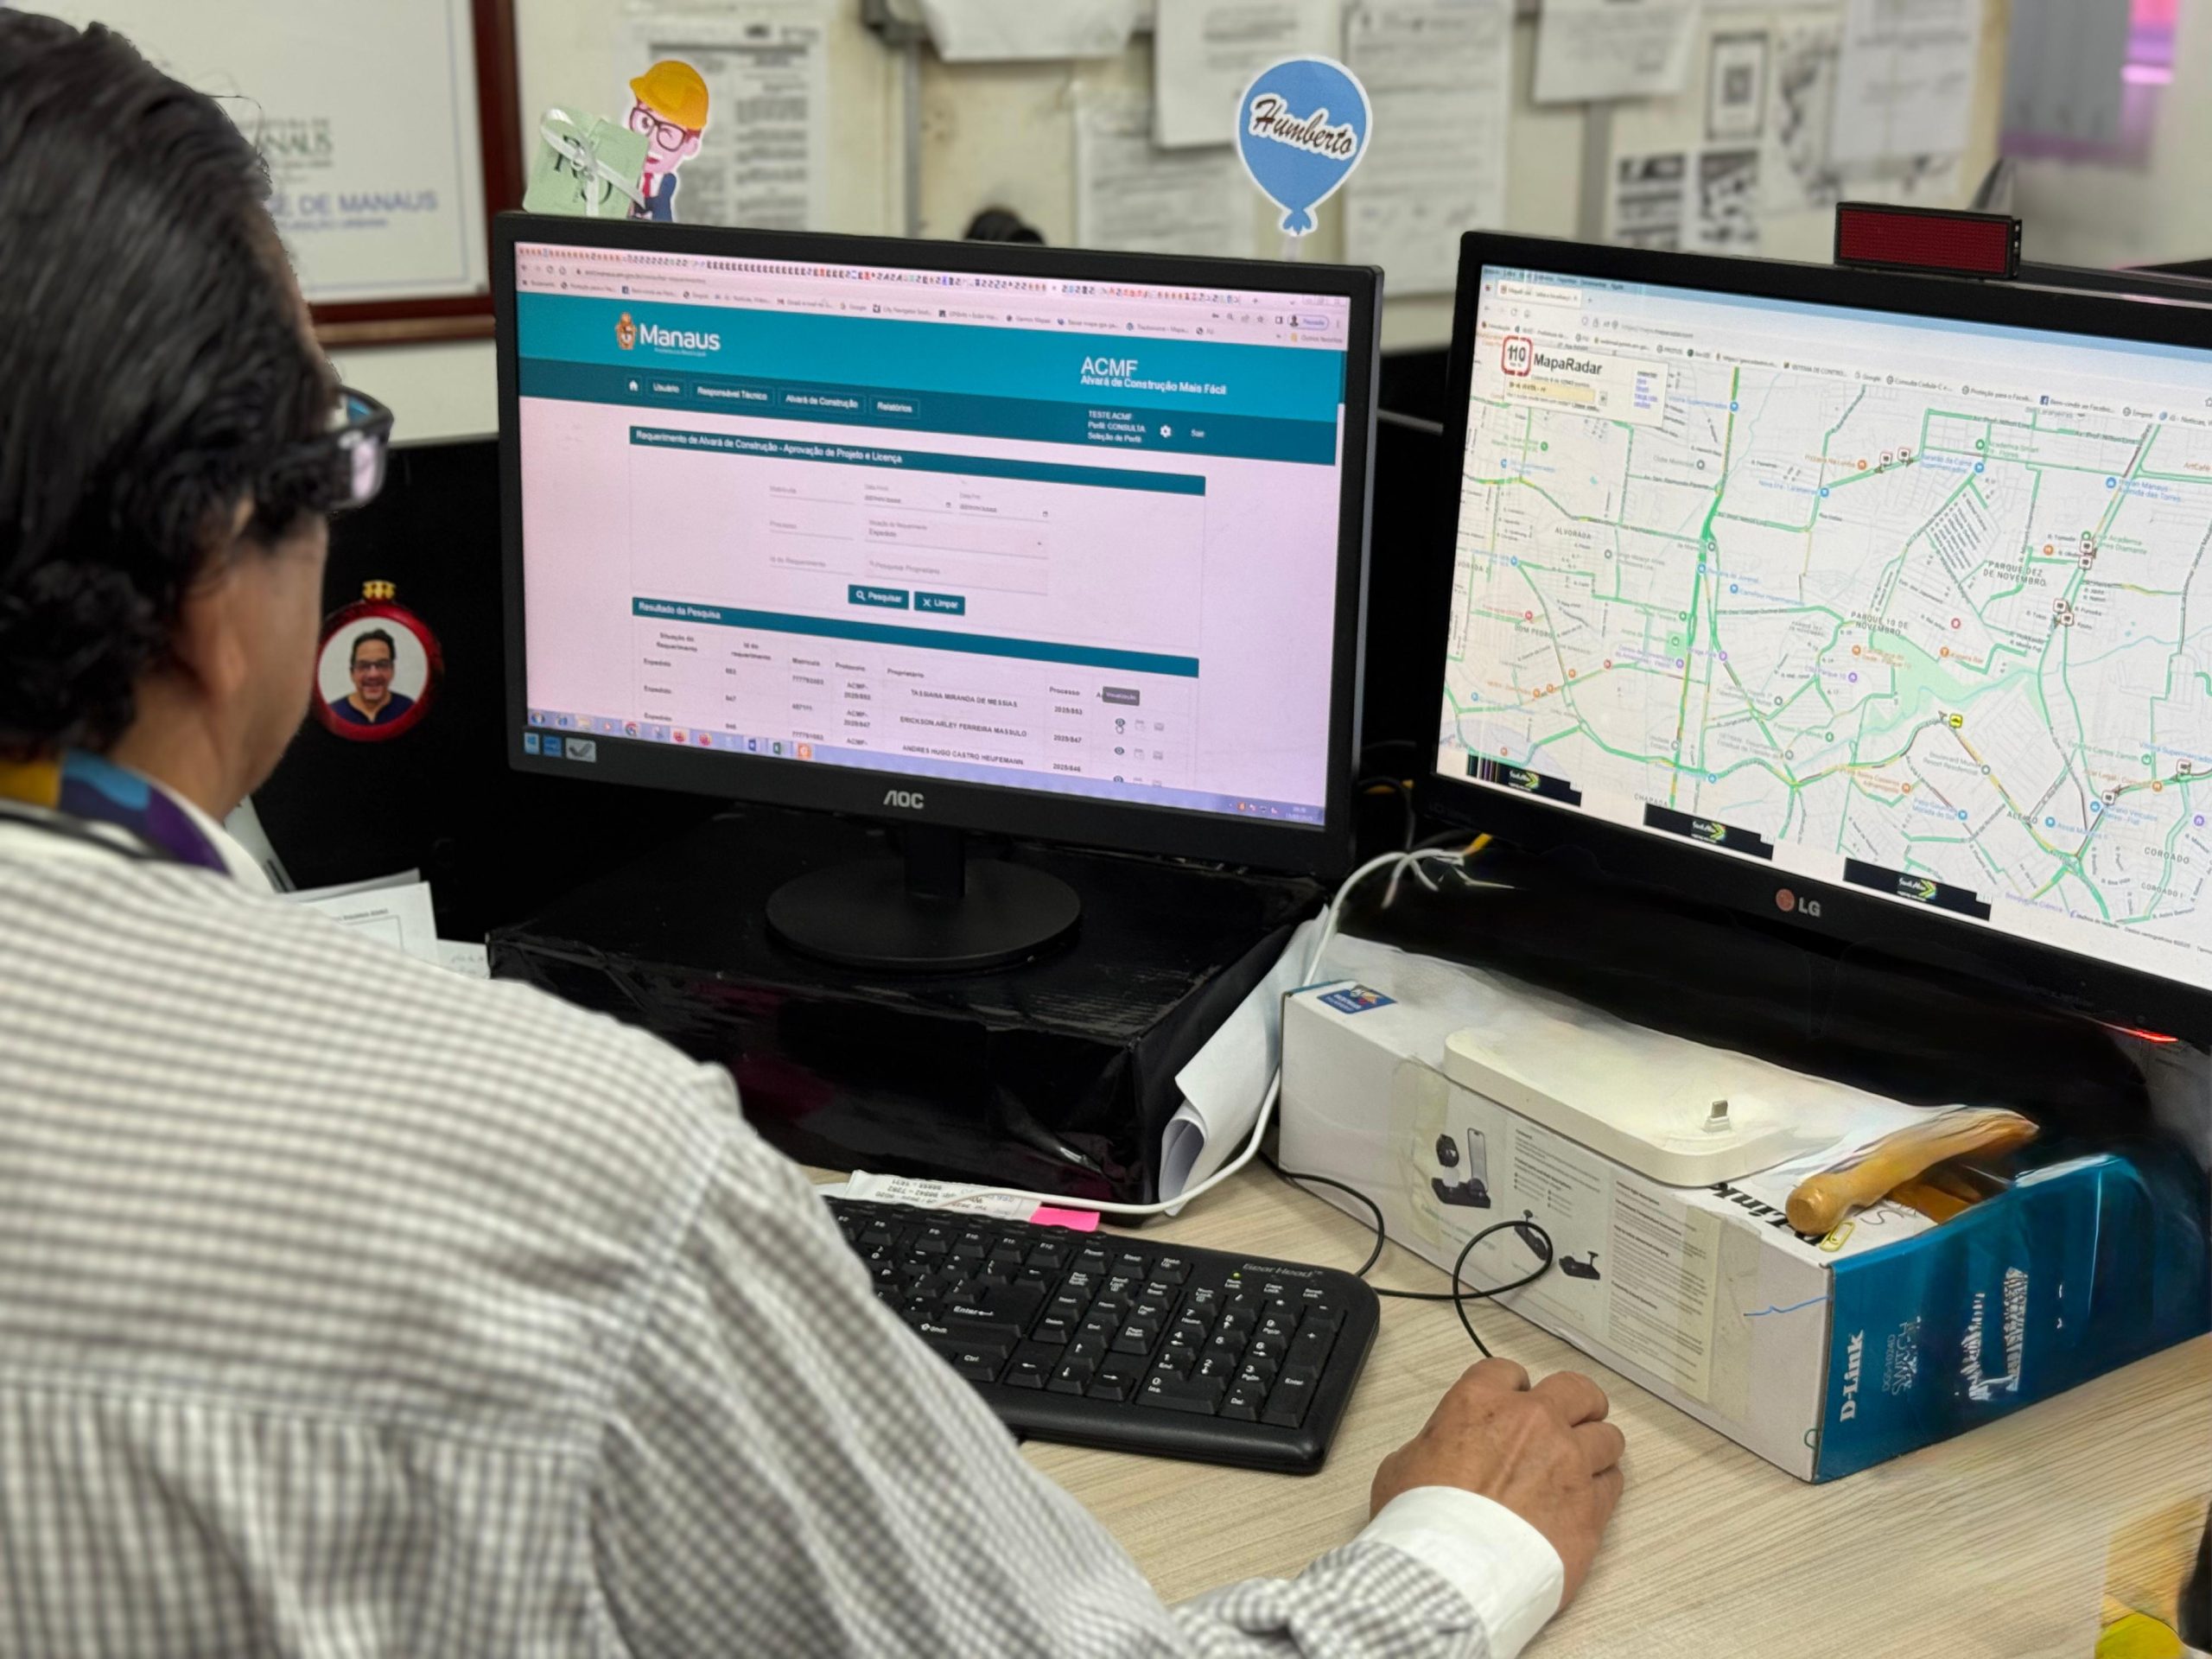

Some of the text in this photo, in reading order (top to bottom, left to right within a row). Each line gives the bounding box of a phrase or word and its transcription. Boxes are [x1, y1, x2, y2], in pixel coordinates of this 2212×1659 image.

[1253, 98, 1352, 156] Humberto
[339, 191, 438, 213] MANAUS
[639, 322, 721, 352] Manaus
[1507, 345, 1526, 363] 110
[1081, 356, 1138, 378] ACMF
[1534, 353, 1603, 376] MapaRadar
[1081, 375, 1227, 396] Alvará de Construção Mais Fácil
[819, 397, 859, 410] Construção
[1107, 423, 1147, 435] CONSULTA
[636, 429, 687, 445] Requerimento
[689, 435, 698, 445] de
[699, 435, 725, 448] Alvará
[725, 439, 734, 448] de
[735, 439, 778, 454] Construção
[784, 443, 823, 458] Aprovação
[824, 448, 836, 457] de
[836, 448, 864, 461] Projeto
[872, 450, 903, 465] Licença
[1554, 526, 1592, 540] ALVORADA
[1983, 569, 1997, 578] DE
[639, 601, 676, 616] Resultado
[687, 607, 721, 620] Pesquisa
[1850, 610, 1885, 625] PARQUE
[1898, 620, 1909, 629] DE
[883, 790, 925, 809] AOC
[1633, 793, 1669, 807] CHAPADA
[2144, 846, 2190, 864] COROADO
[2141, 882, 2178, 898] COROADO
[1798, 897, 1821, 918] LG
[953, 1306, 977, 1316] Enter
[1225, 1314, 1234, 1323] 8
[963, 1354, 979, 1363] Ctrl
[1891, 1320, 1910, 1396] SWITCH
[1840, 1329, 1865, 1423] D-Link
